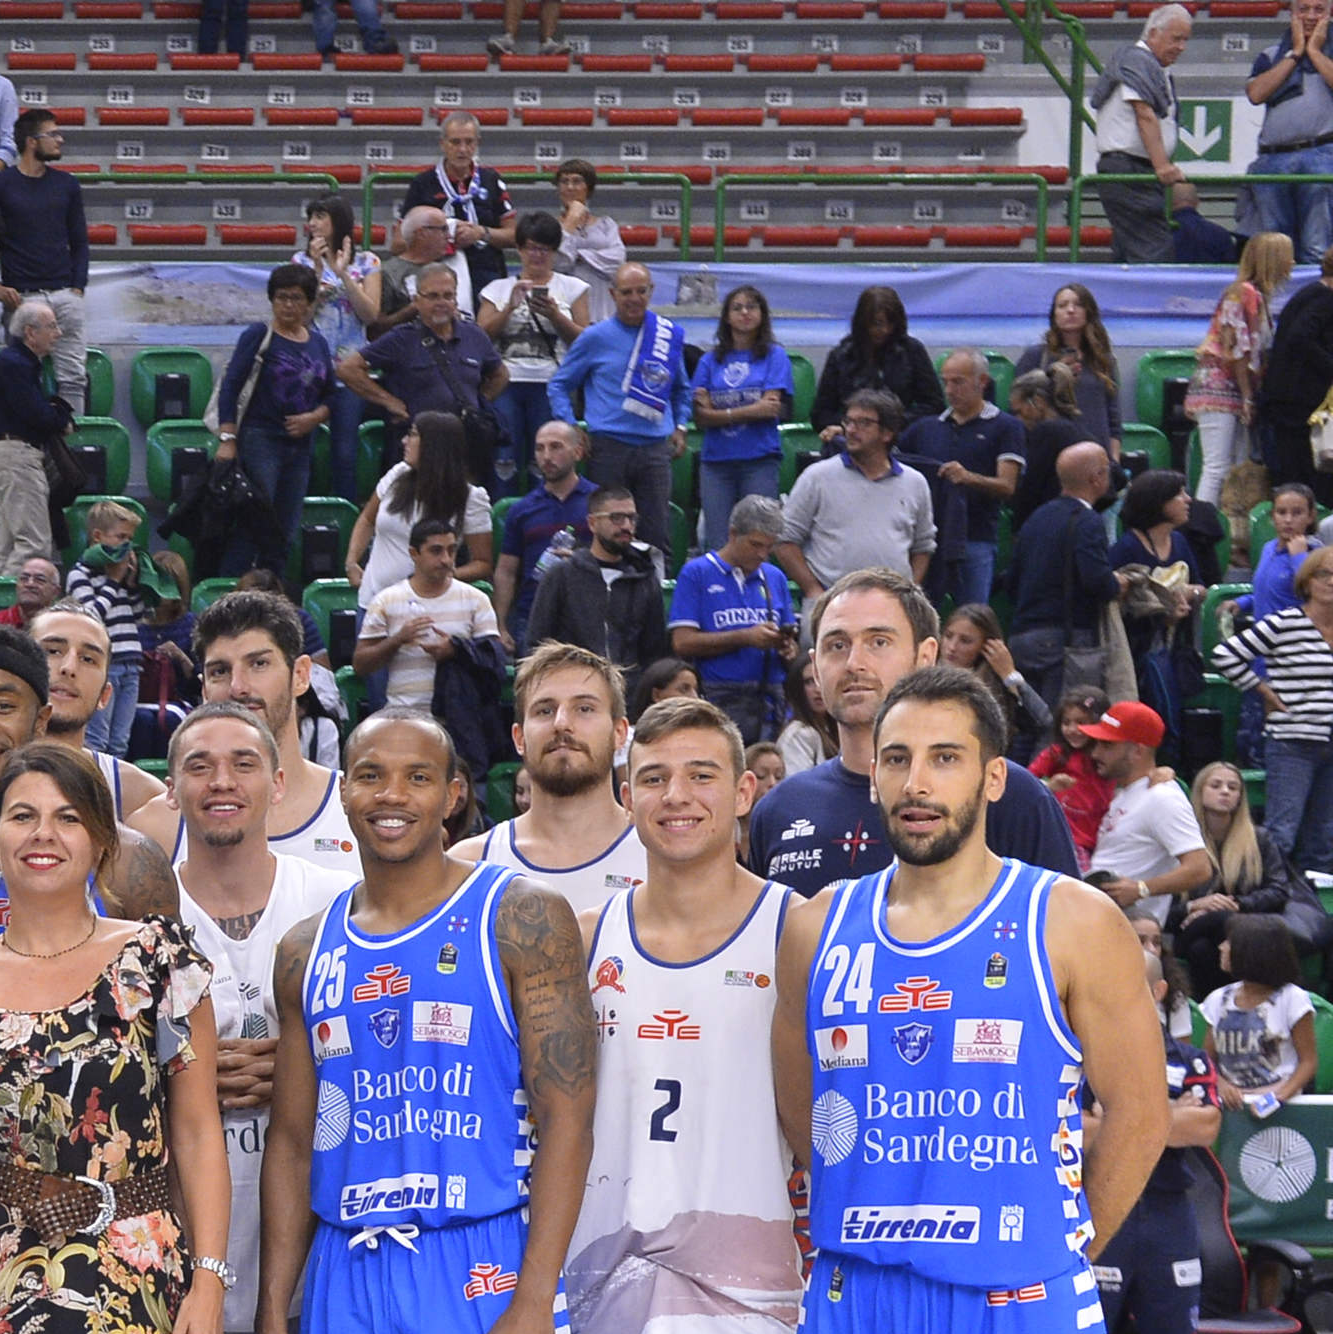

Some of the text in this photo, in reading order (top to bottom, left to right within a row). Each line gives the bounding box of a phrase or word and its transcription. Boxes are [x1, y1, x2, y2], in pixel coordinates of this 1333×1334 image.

[779, 861, 821, 873] MUTUA
[781, 849, 823, 863] REALE
[312, 944, 347, 1015] 25
[822, 942, 873, 1016] 24
[443, 1063, 472, 1098] di
[353, 1097, 482, 1144] Sardegna
[649, 1079, 682, 1143] 2
[864, 1083, 1025, 1119] Banco di
[863, 1127, 1039, 1171] Sardegna
[845, 1206, 978, 1241] tirrenia
